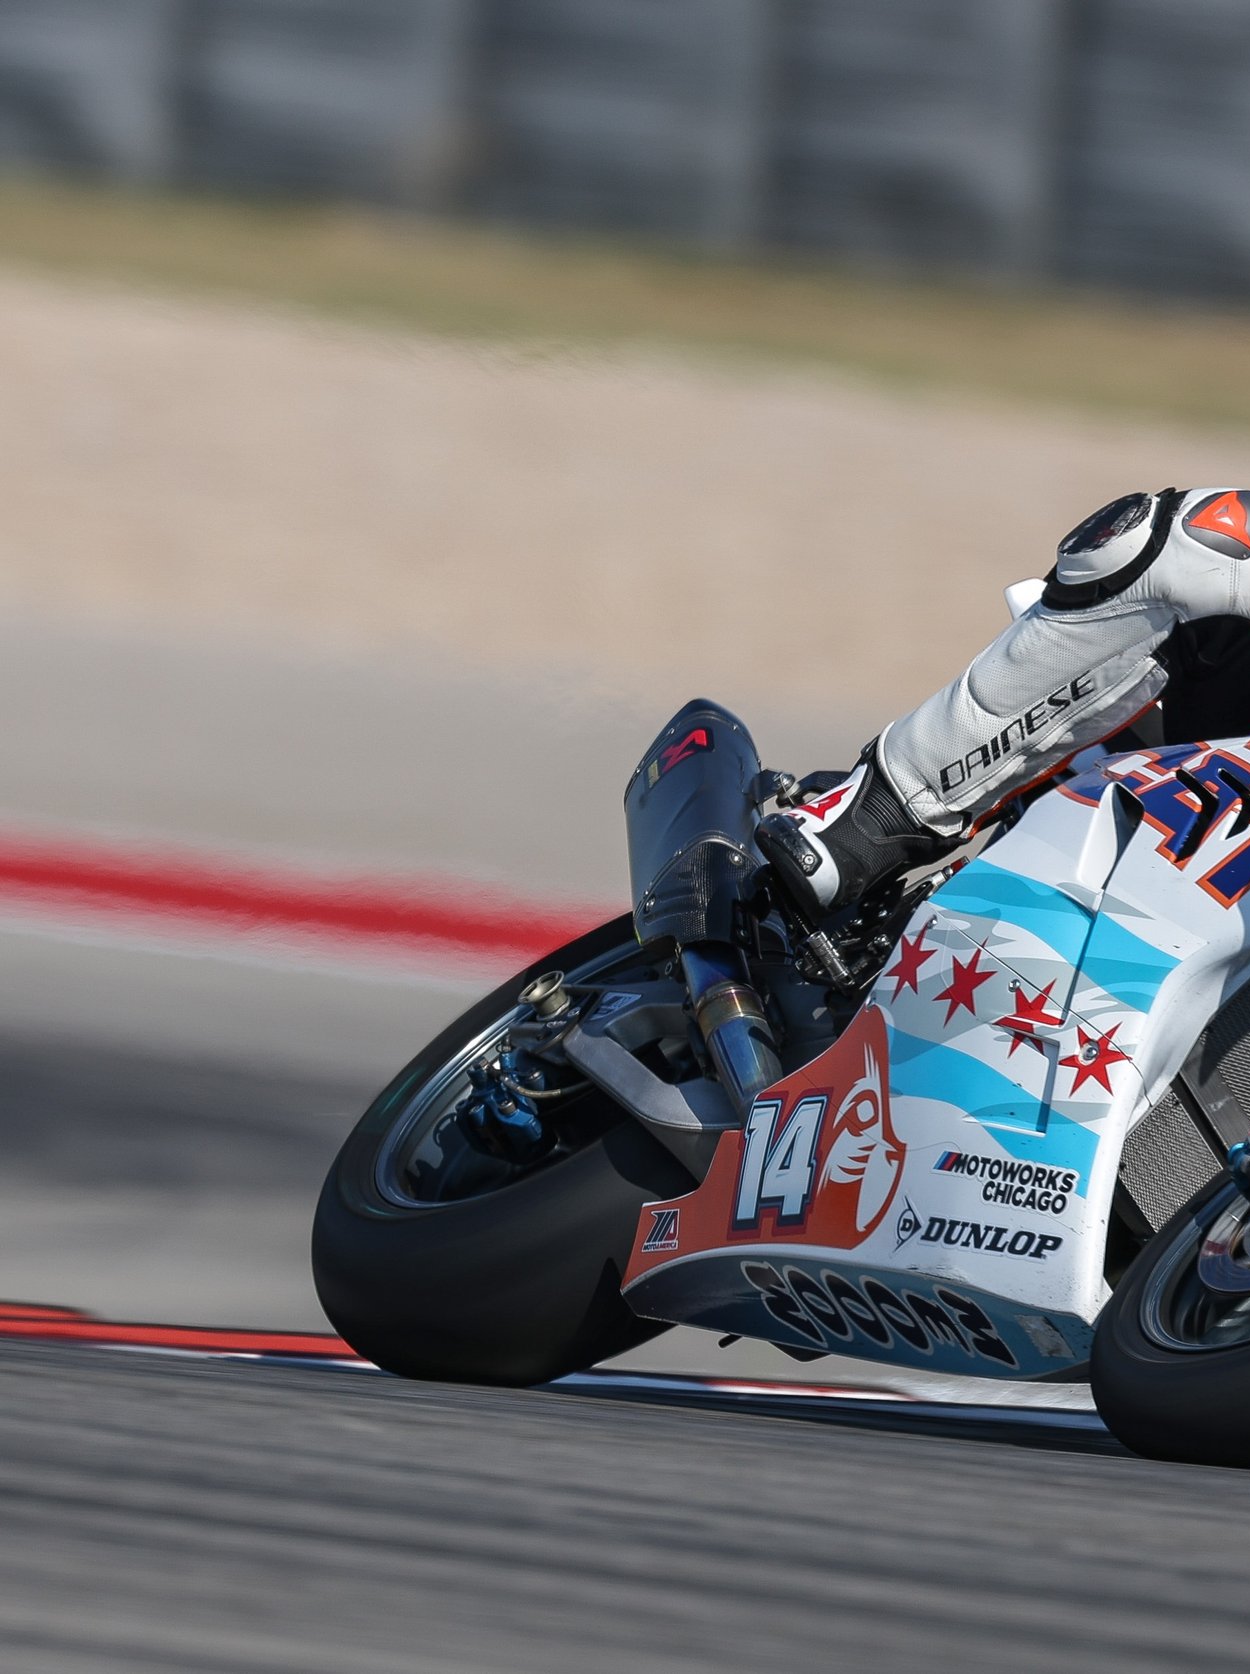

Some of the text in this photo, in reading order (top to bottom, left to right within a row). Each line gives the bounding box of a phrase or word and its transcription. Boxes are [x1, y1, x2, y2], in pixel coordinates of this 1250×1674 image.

[939, 670, 1095, 793] DAINESE
[731, 1093, 829, 1233] 14
[952, 1153, 1076, 1194] MOTOWORKS
[982, 1181, 1067, 1214] CHICAGO
[920, 1216, 1063, 1259] DUNLOP
